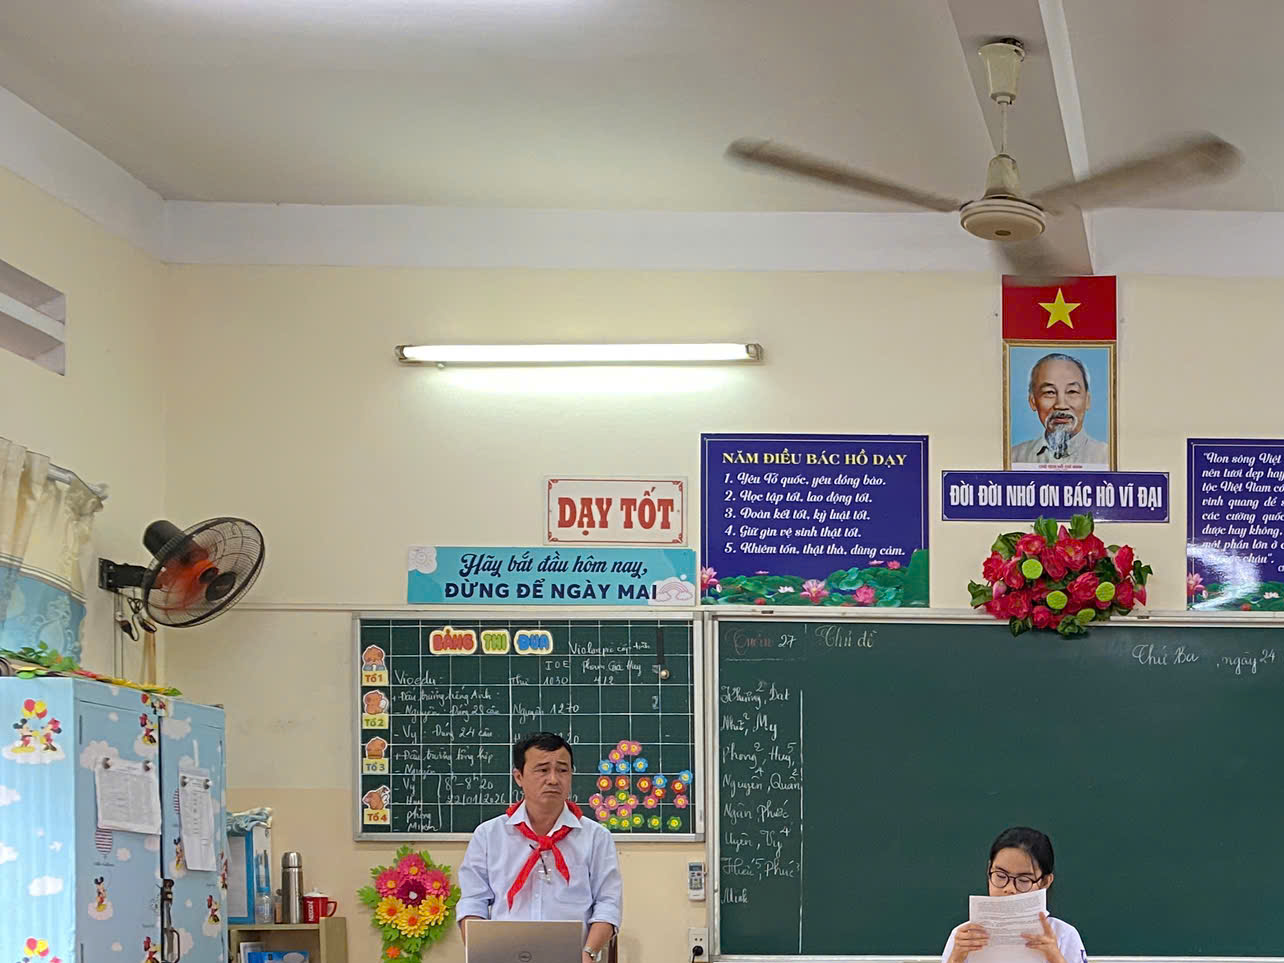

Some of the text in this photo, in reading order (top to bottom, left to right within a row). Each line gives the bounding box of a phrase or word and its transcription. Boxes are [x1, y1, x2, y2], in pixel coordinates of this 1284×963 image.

[722, 448, 907, 468] NĂM ĐIỀU BÁC HỒ DẠY
[724, 473, 733, 484] 1.
[724, 491, 736, 502] 2.
[950, 480, 1162, 510] ĐỜI ĐỜI NHỚ ƠN BÁC HỒ VĨ ĐẠI
[557, 487, 674, 536] DẠY TỐT
[725, 508, 736, 518] 3.
[725, 525, 736, 536] 4.
[725, 543, 736, 553] 5.
[459, 551, 648, 578] Hãy bắt đầu hôm nay,
[445, 579, 657, 599] ĐỪNG ĐỂ NGÀY MAI
[433, 629, 549, 650] BẢNG THI ĐUA
[1260, 650, 1275, 664] 24
[365, 674, 383, 682] Tổ 1
[364, 718, 376, 727] Tổ
[366, 763, 385, 771] Tổ 3
[368, 813, 387, 821] Tổ 4
